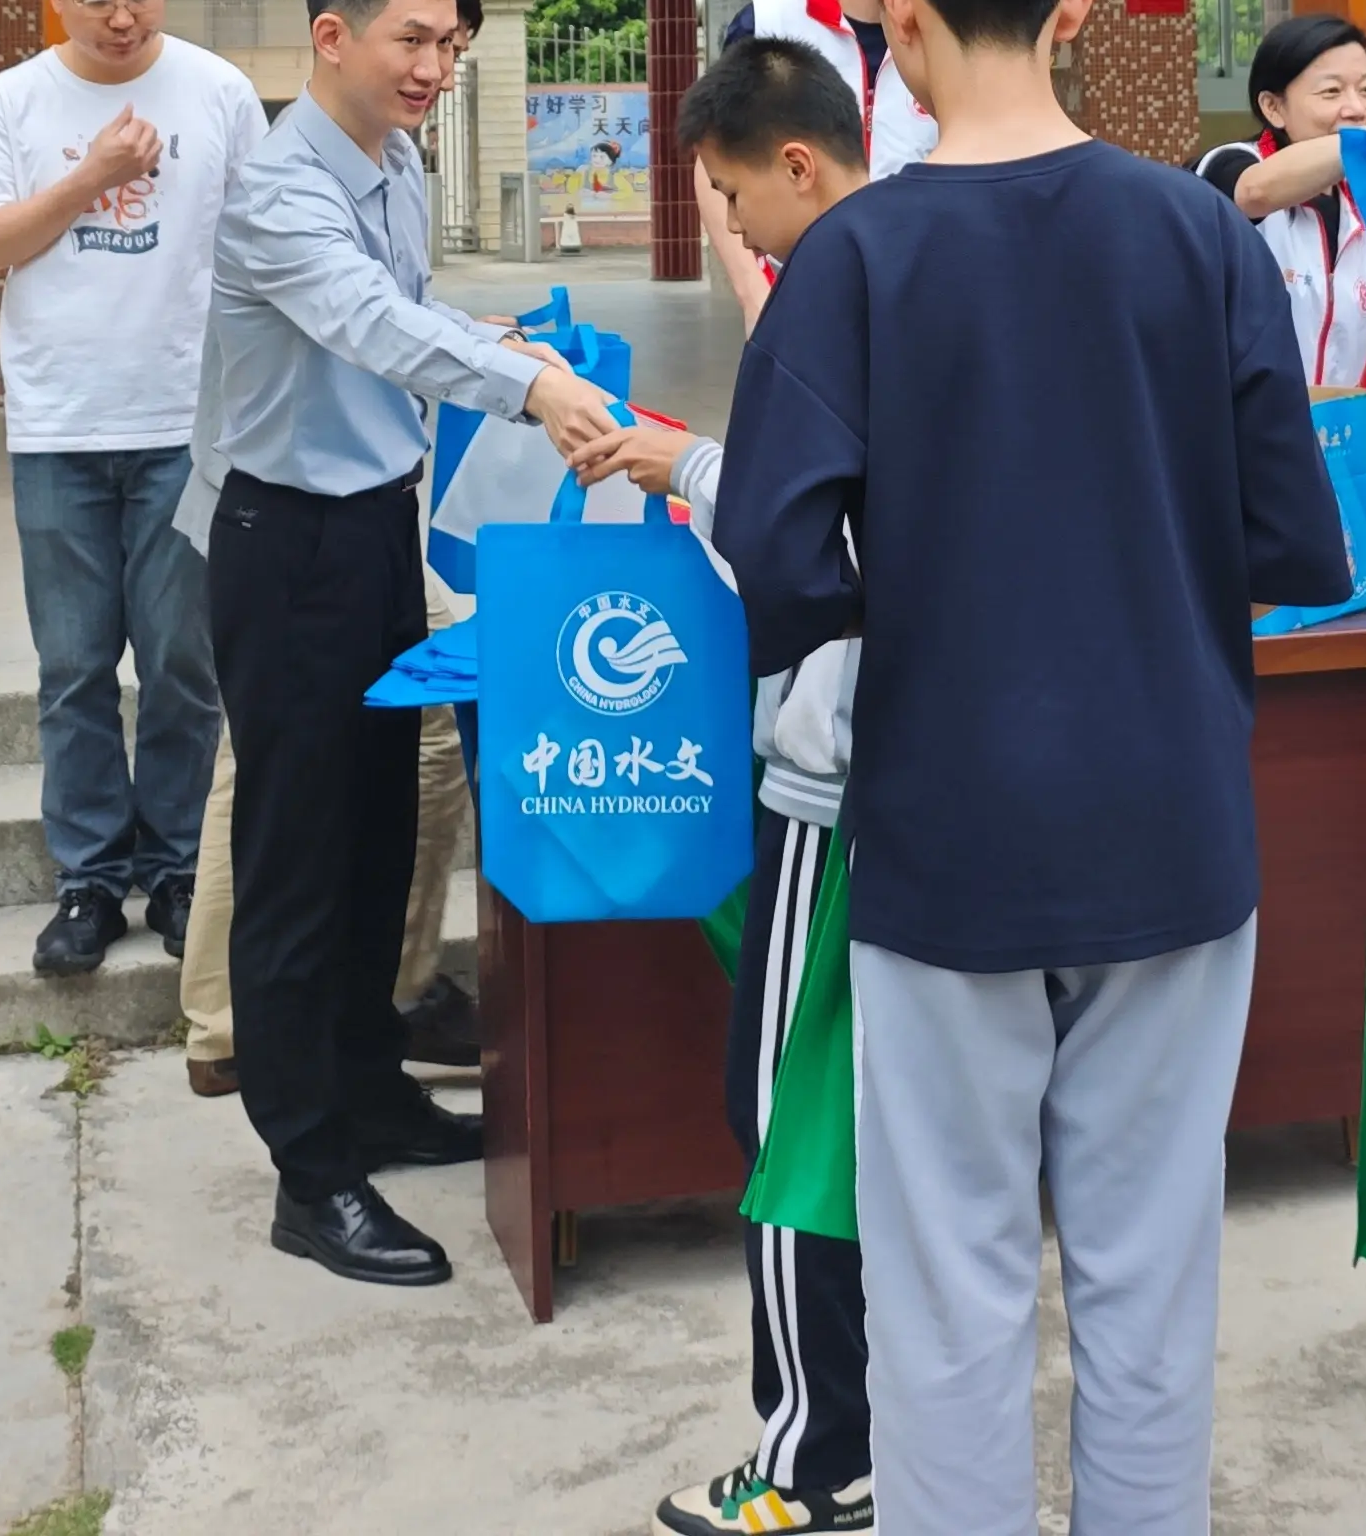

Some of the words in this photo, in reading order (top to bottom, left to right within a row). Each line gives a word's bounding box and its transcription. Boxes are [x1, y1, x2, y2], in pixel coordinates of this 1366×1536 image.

[522, 732, 714, 795] 中国水文
[521, 795, 585, 815] CHINA
[590, 795, 713, 814] HYDROLOGY
